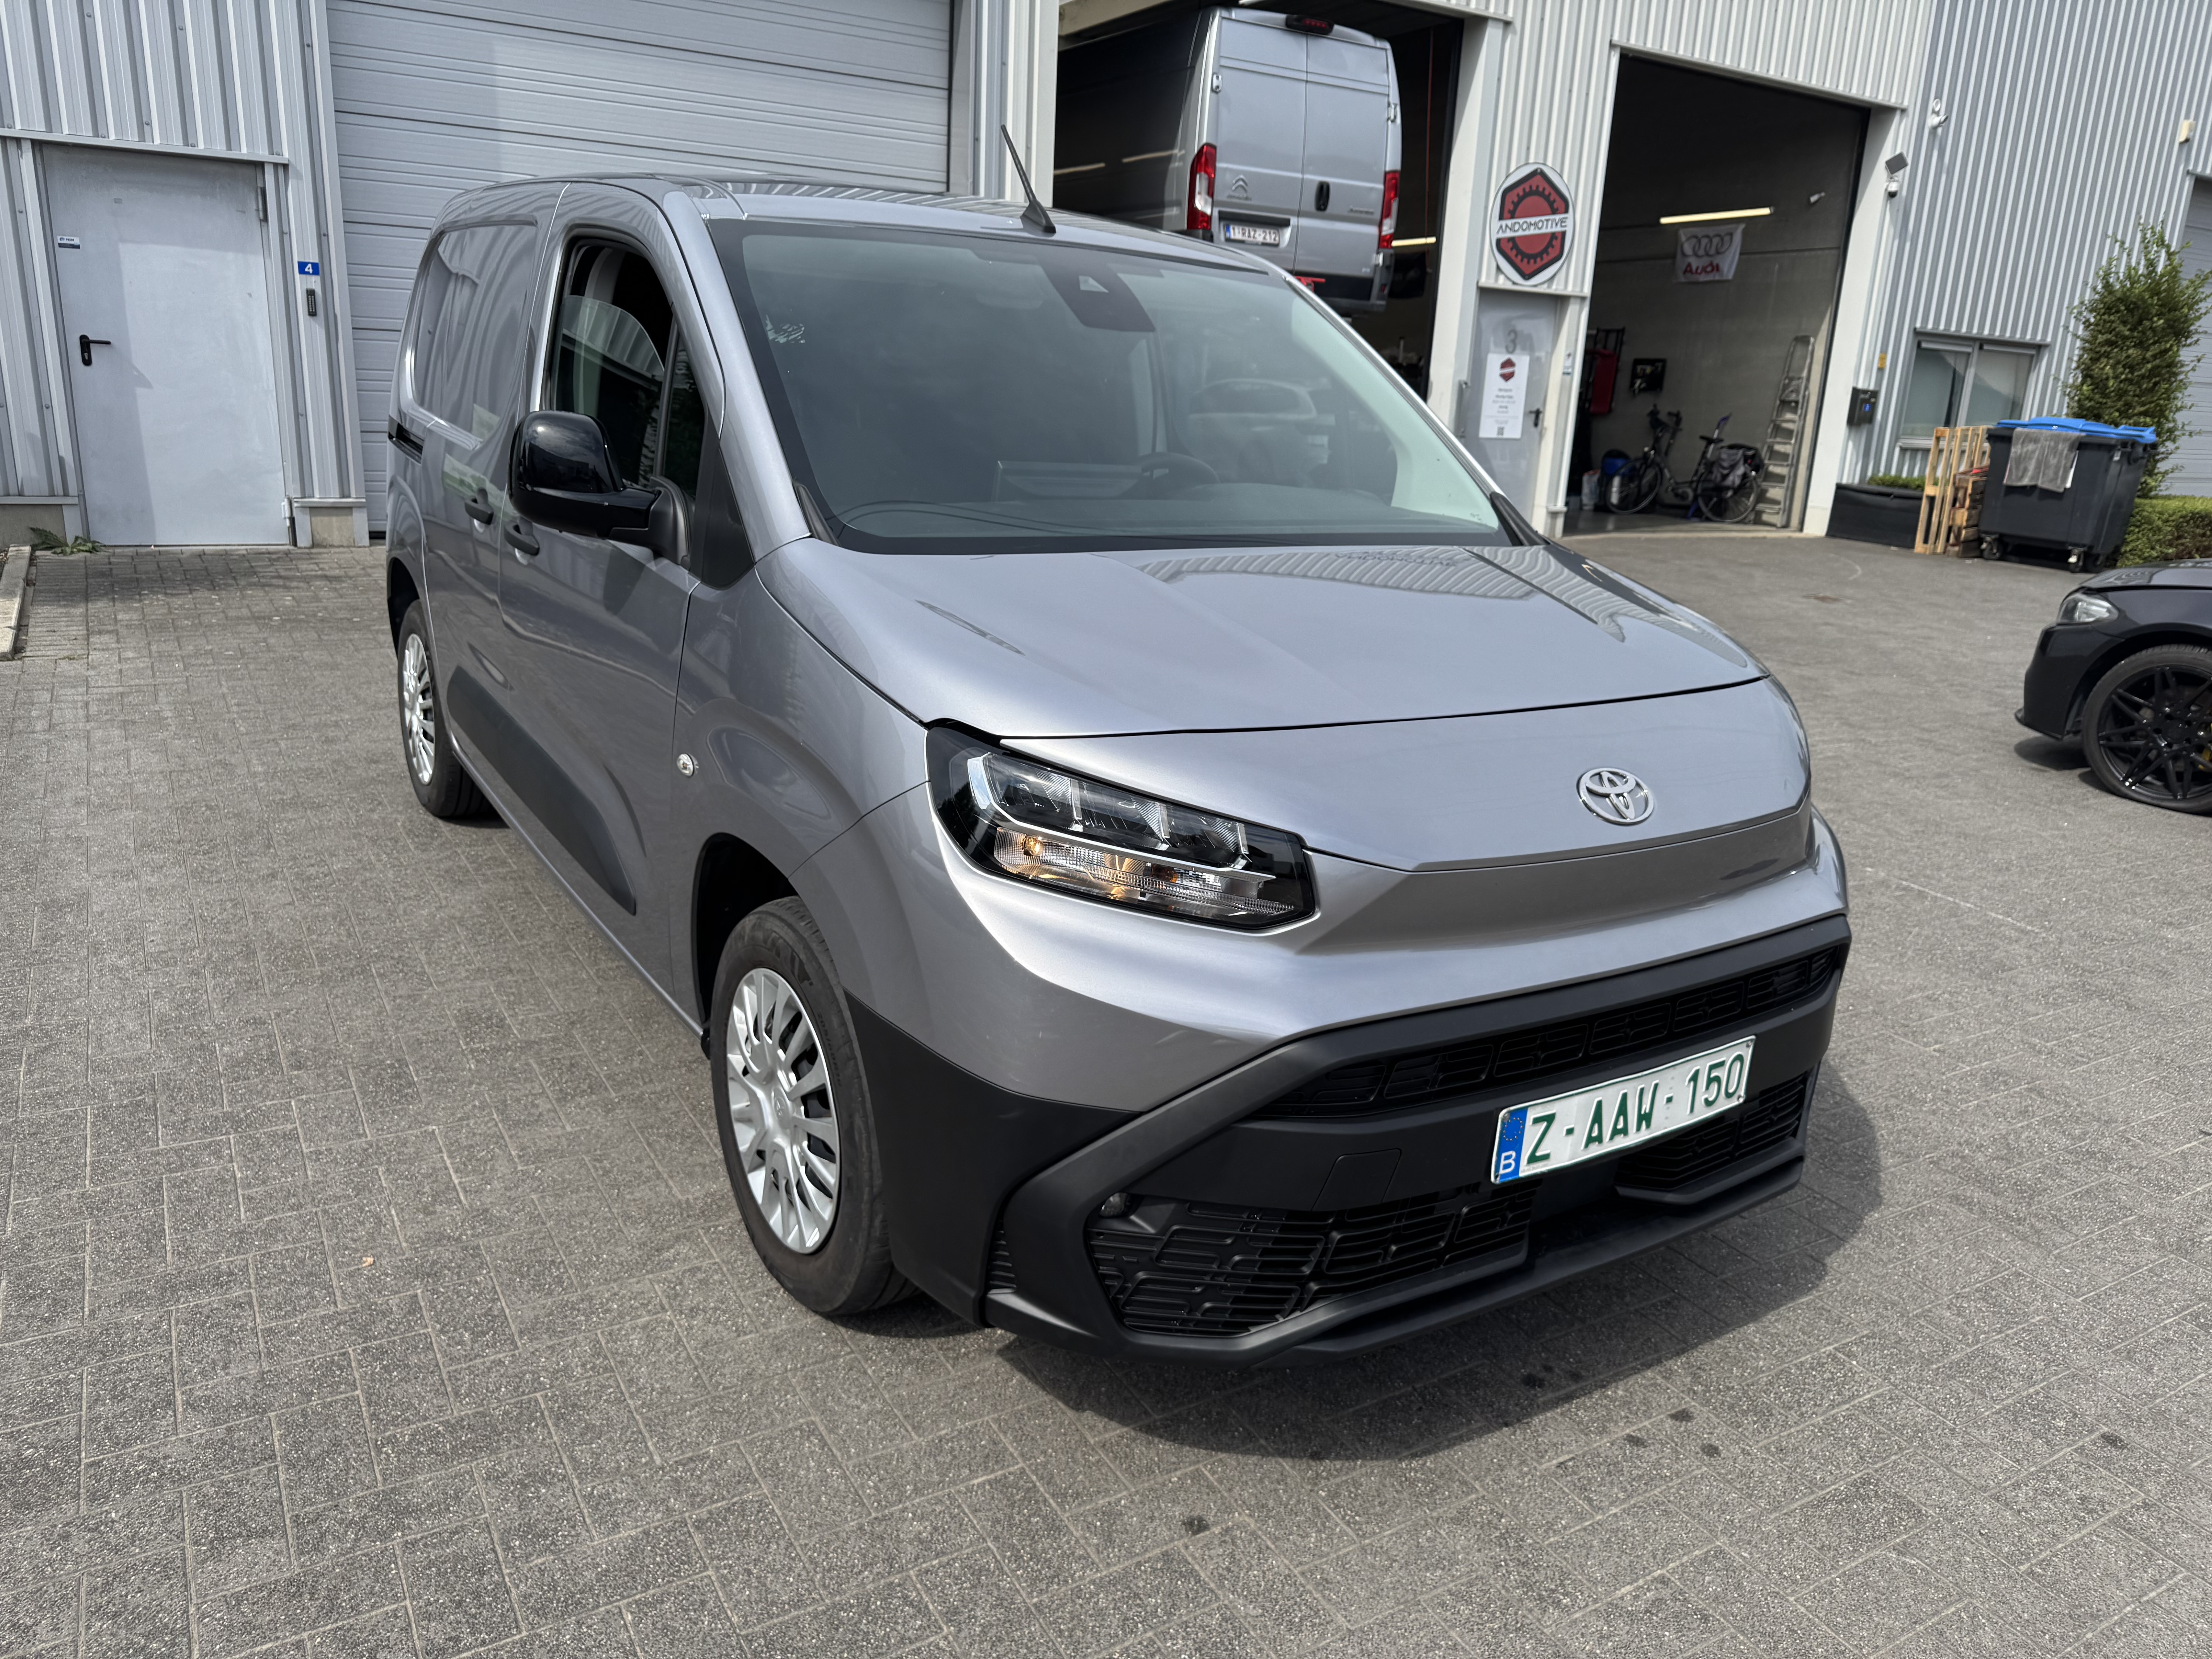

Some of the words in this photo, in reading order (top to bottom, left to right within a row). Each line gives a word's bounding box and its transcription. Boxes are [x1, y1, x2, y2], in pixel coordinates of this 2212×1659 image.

[1496, 216, 1568, 234] ANDOMOTIVE
[305, 263, 313, 273] 4
[1505, 330, 1517, 354] 3
[1524, 1051, 1744, 1166] Z-AAW-150
[1499, 1150, 1515, 1175] B
